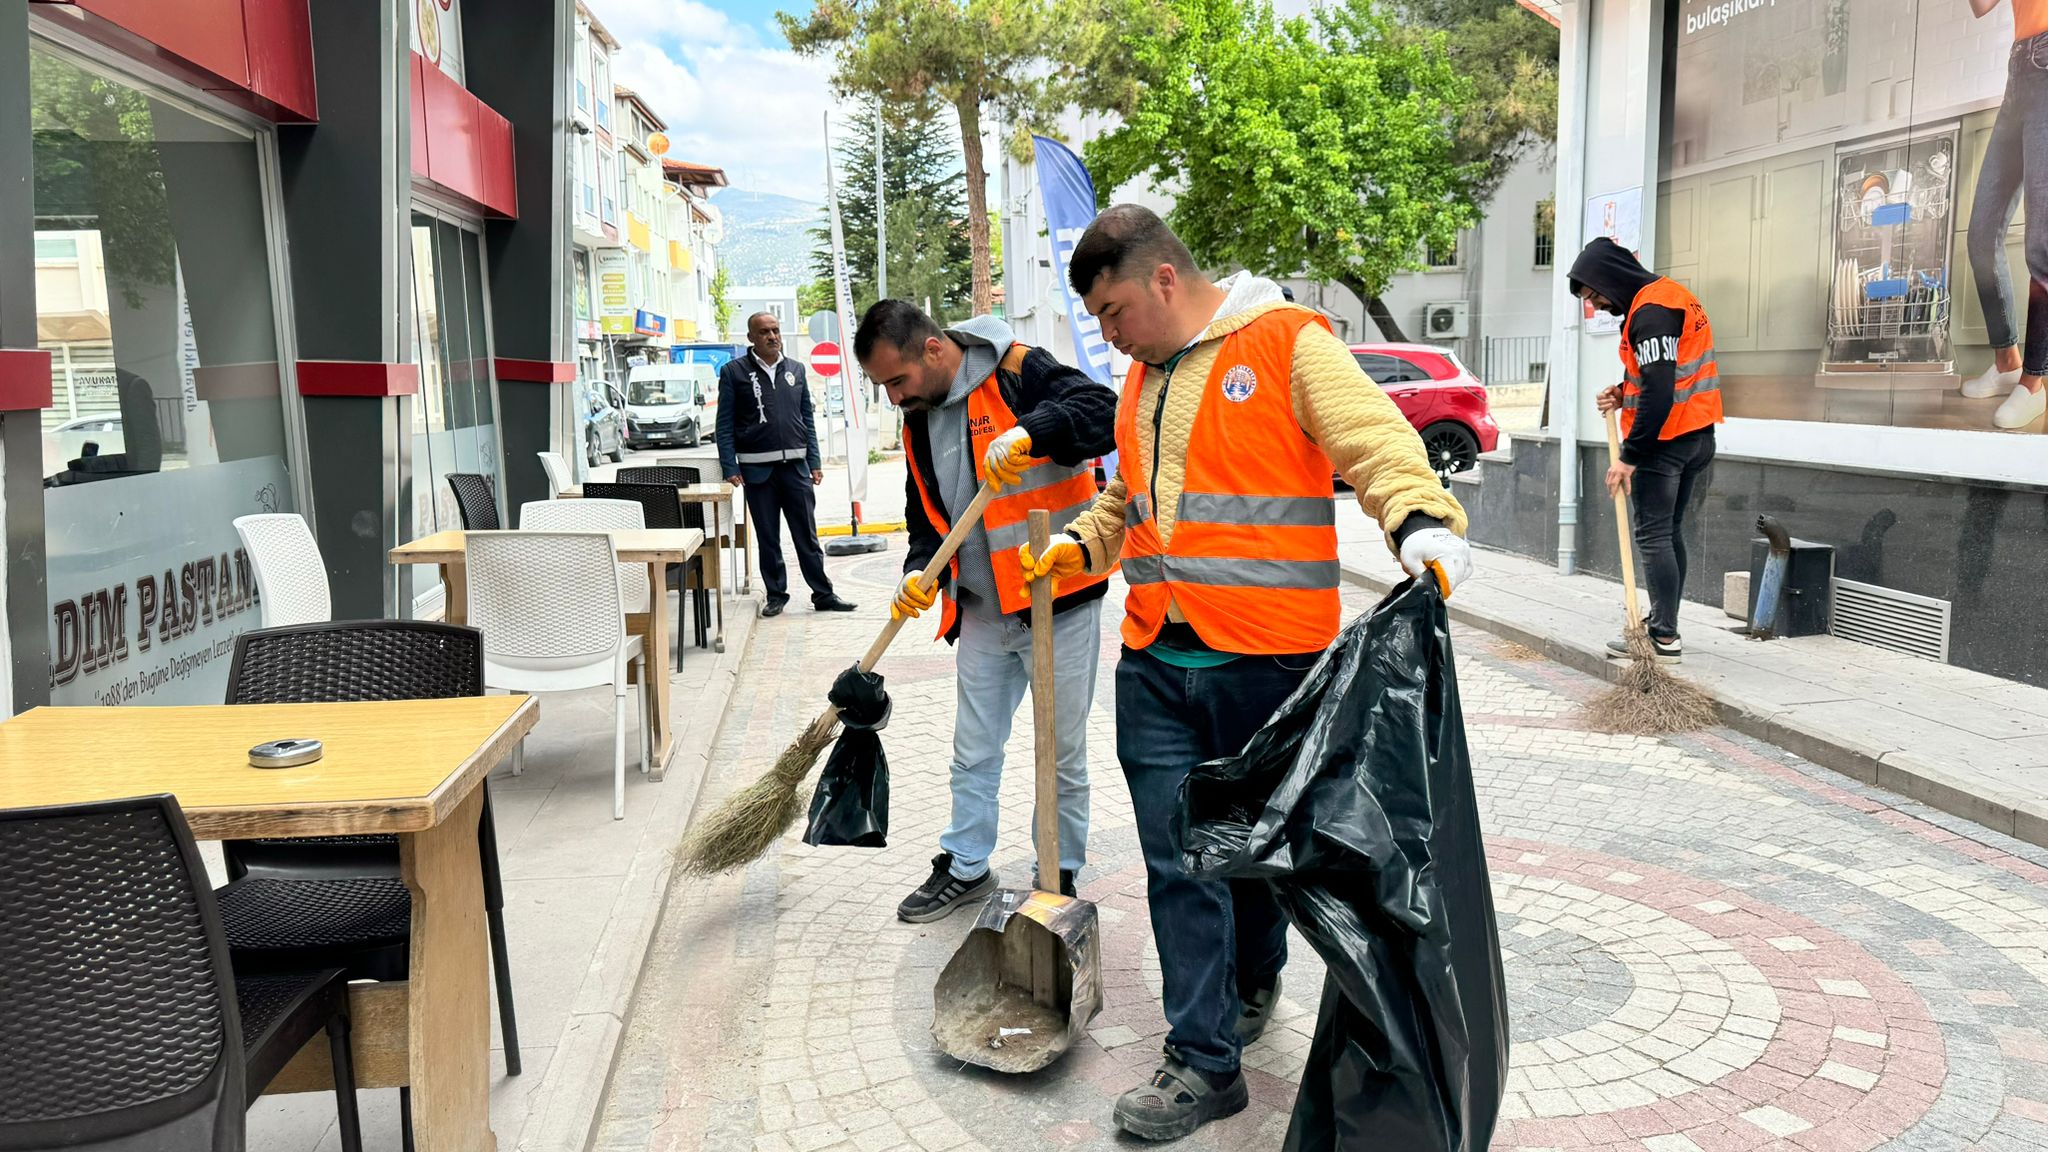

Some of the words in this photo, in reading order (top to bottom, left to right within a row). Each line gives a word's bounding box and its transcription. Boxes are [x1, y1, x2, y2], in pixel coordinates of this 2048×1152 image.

[749, 371, 768, 424] ZABITA
[49, 582, 129, 690] DIM
[136, 547, 260, 654] PASTAN
